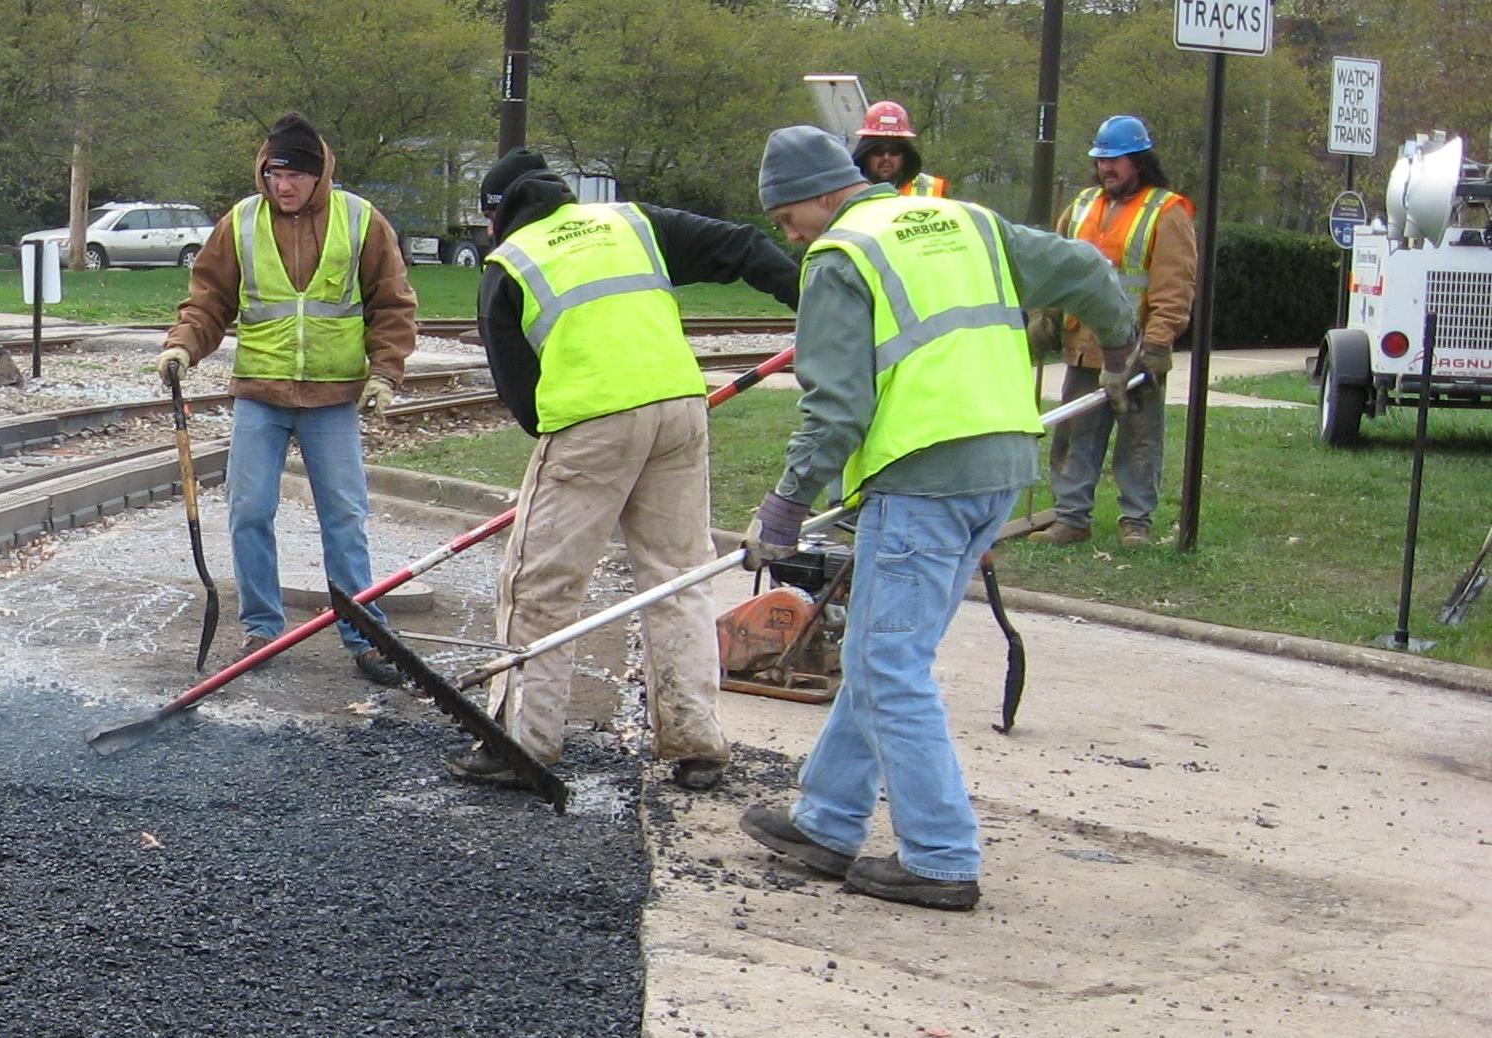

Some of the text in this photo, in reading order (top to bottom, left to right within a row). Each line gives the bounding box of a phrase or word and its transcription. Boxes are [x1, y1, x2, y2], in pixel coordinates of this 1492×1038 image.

[1183, 0, 1261, 32] TRACKS
[1337, 68, 1375, 88] WATCH
[1334, 125, 1372, 145] TRAINS
[895, 219, 960, 240] BARBICAS
